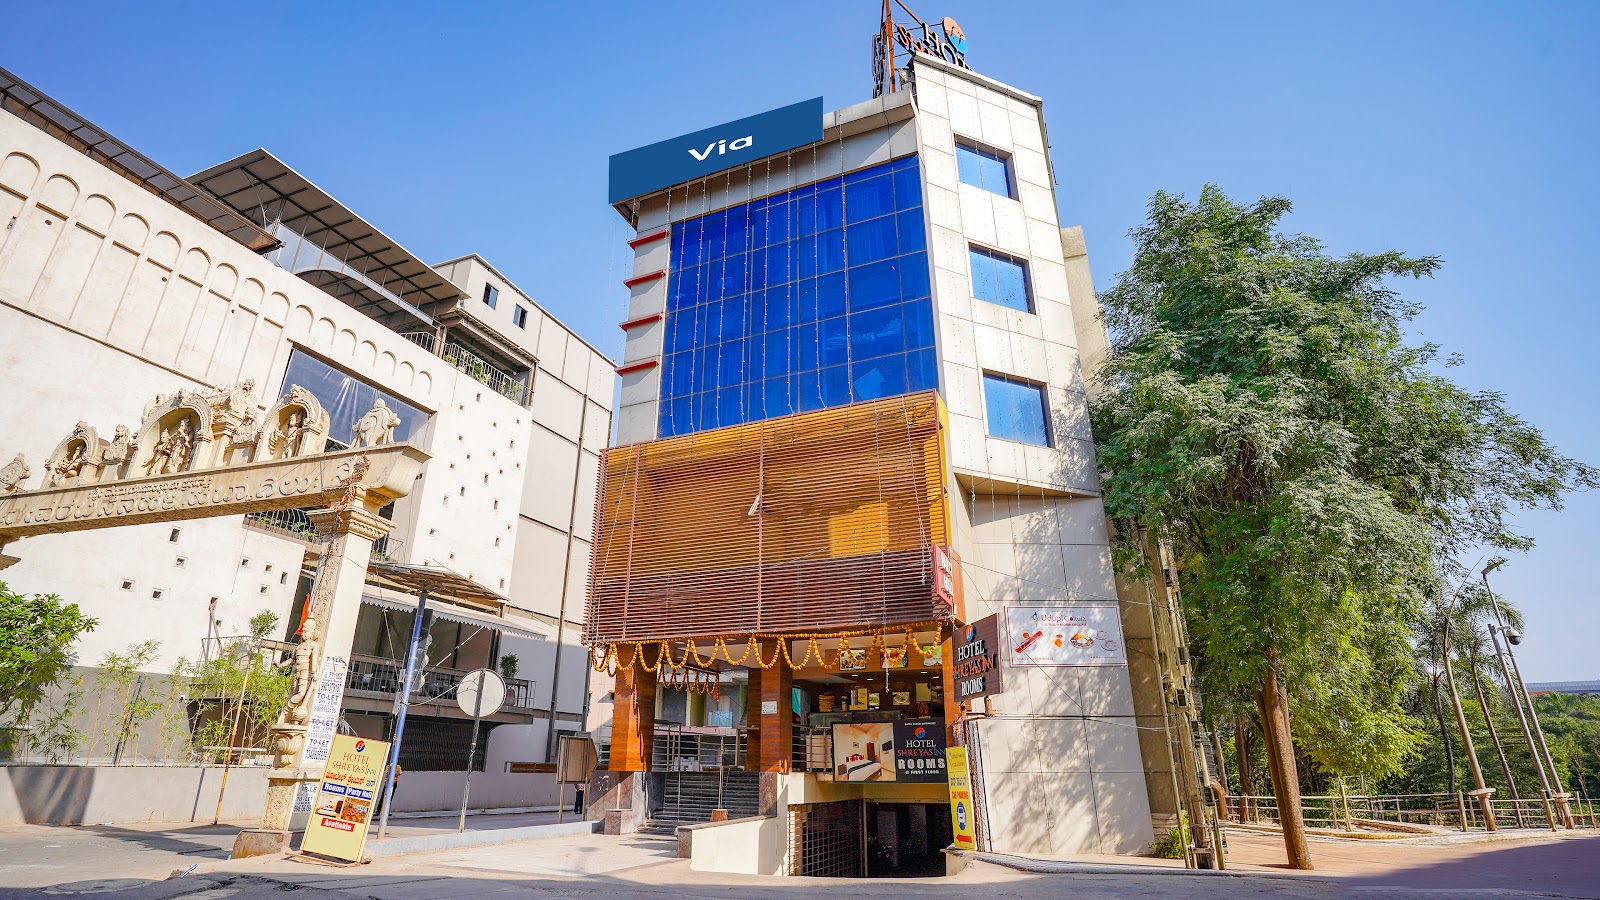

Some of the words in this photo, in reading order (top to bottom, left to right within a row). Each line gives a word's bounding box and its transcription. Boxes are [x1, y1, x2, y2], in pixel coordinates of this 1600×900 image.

[688, 135, 752, 161] Via
[957, 640, 985, 661] HOTEL
[961, 677, 983, 696] ROOMS
[317, 692, 340, 701] TO-LET
[311, 718, 335, 728] TO-LET
[310, 738, 330, 747] TO-LET
[906, 740, 936, 748] HOTEL
[342, 752, 370, 765] HOTEL
[897, 748, 933, 757] SHREYAS
[332, 760, 365, 774] SHREYAS
[897, 758, 946, 770] ROOMS
[324, 783, 345, 793] Rooms
[348, 787, 362, 797] Party
[362, 789, 373, 799] Hall
[323, 819, 352, 831] Available
